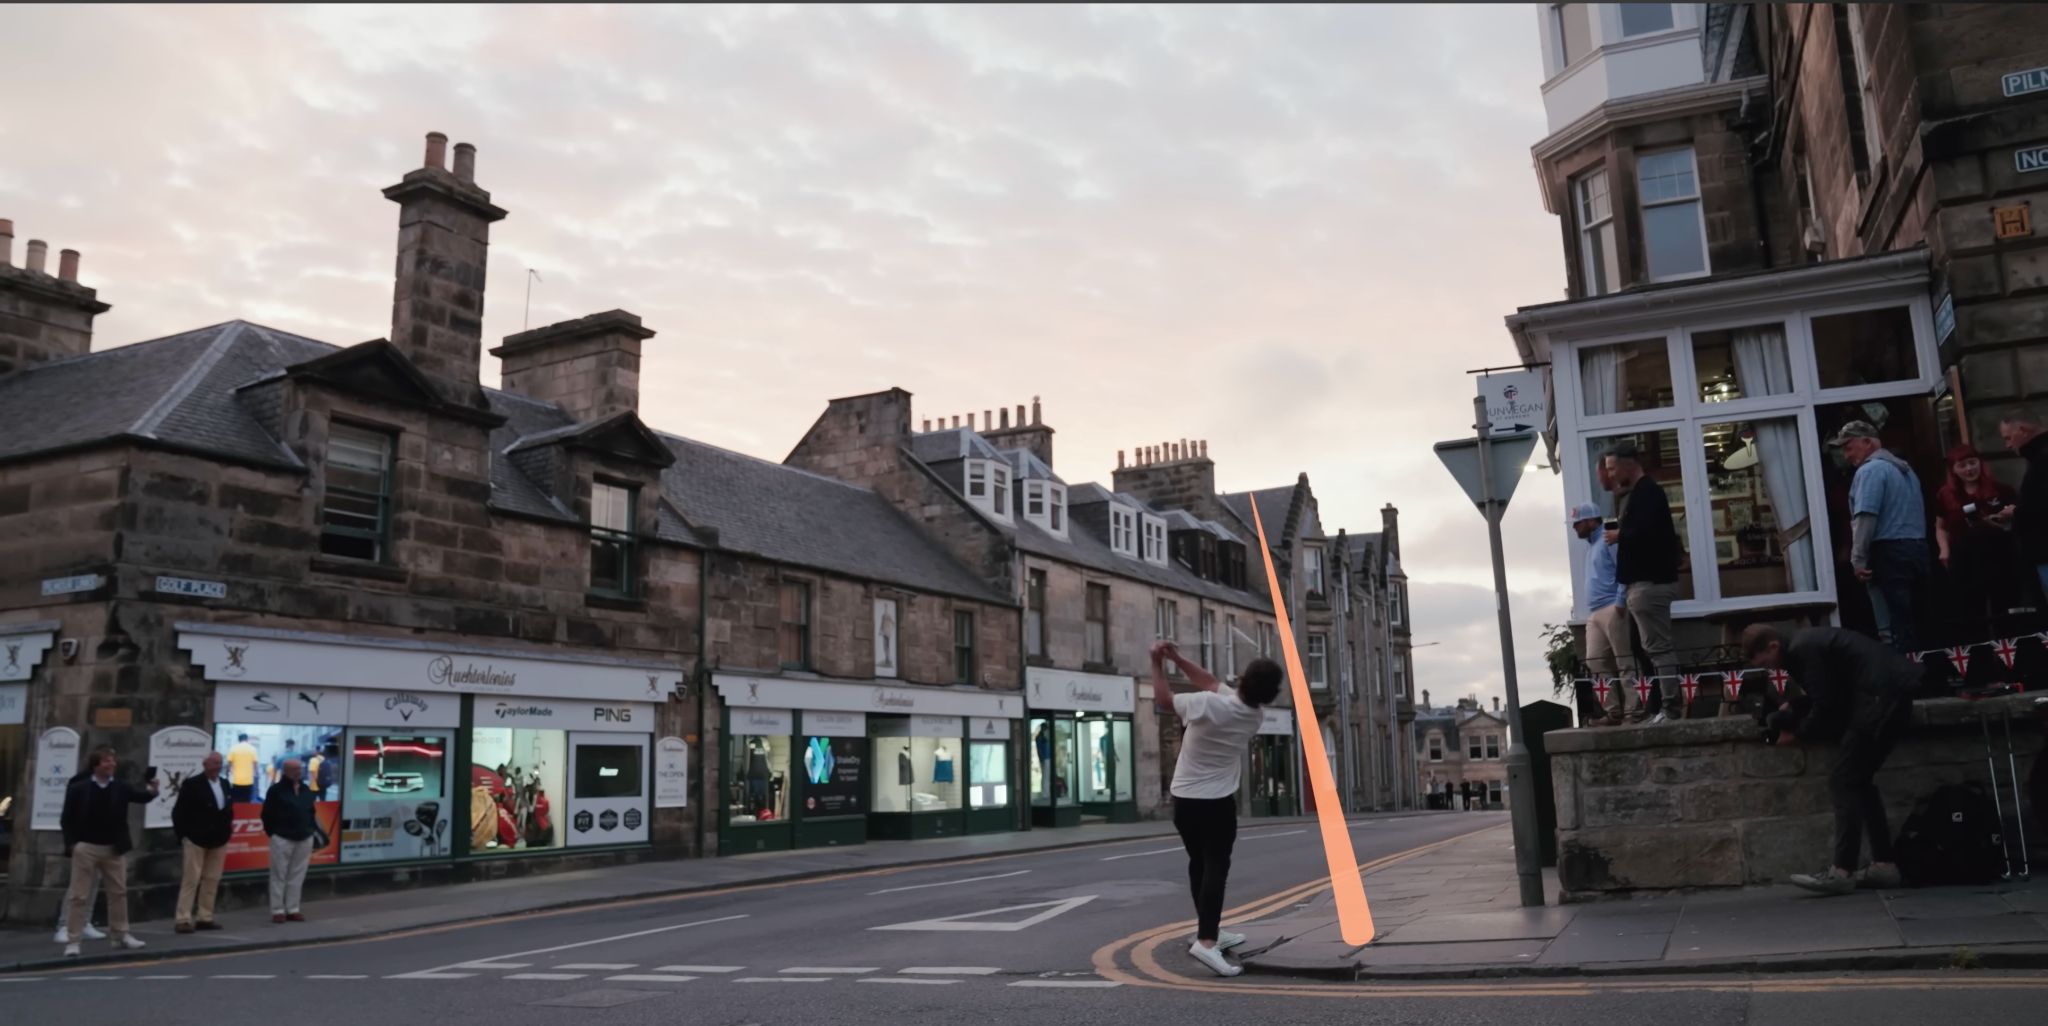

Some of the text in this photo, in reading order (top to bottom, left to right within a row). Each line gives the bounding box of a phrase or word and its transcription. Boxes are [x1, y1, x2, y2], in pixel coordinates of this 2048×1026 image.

[384, 692, 429, 712] Callaway
[495, 702, 552, 718] TaylorMade
[593, 707, 632, 723] PING
